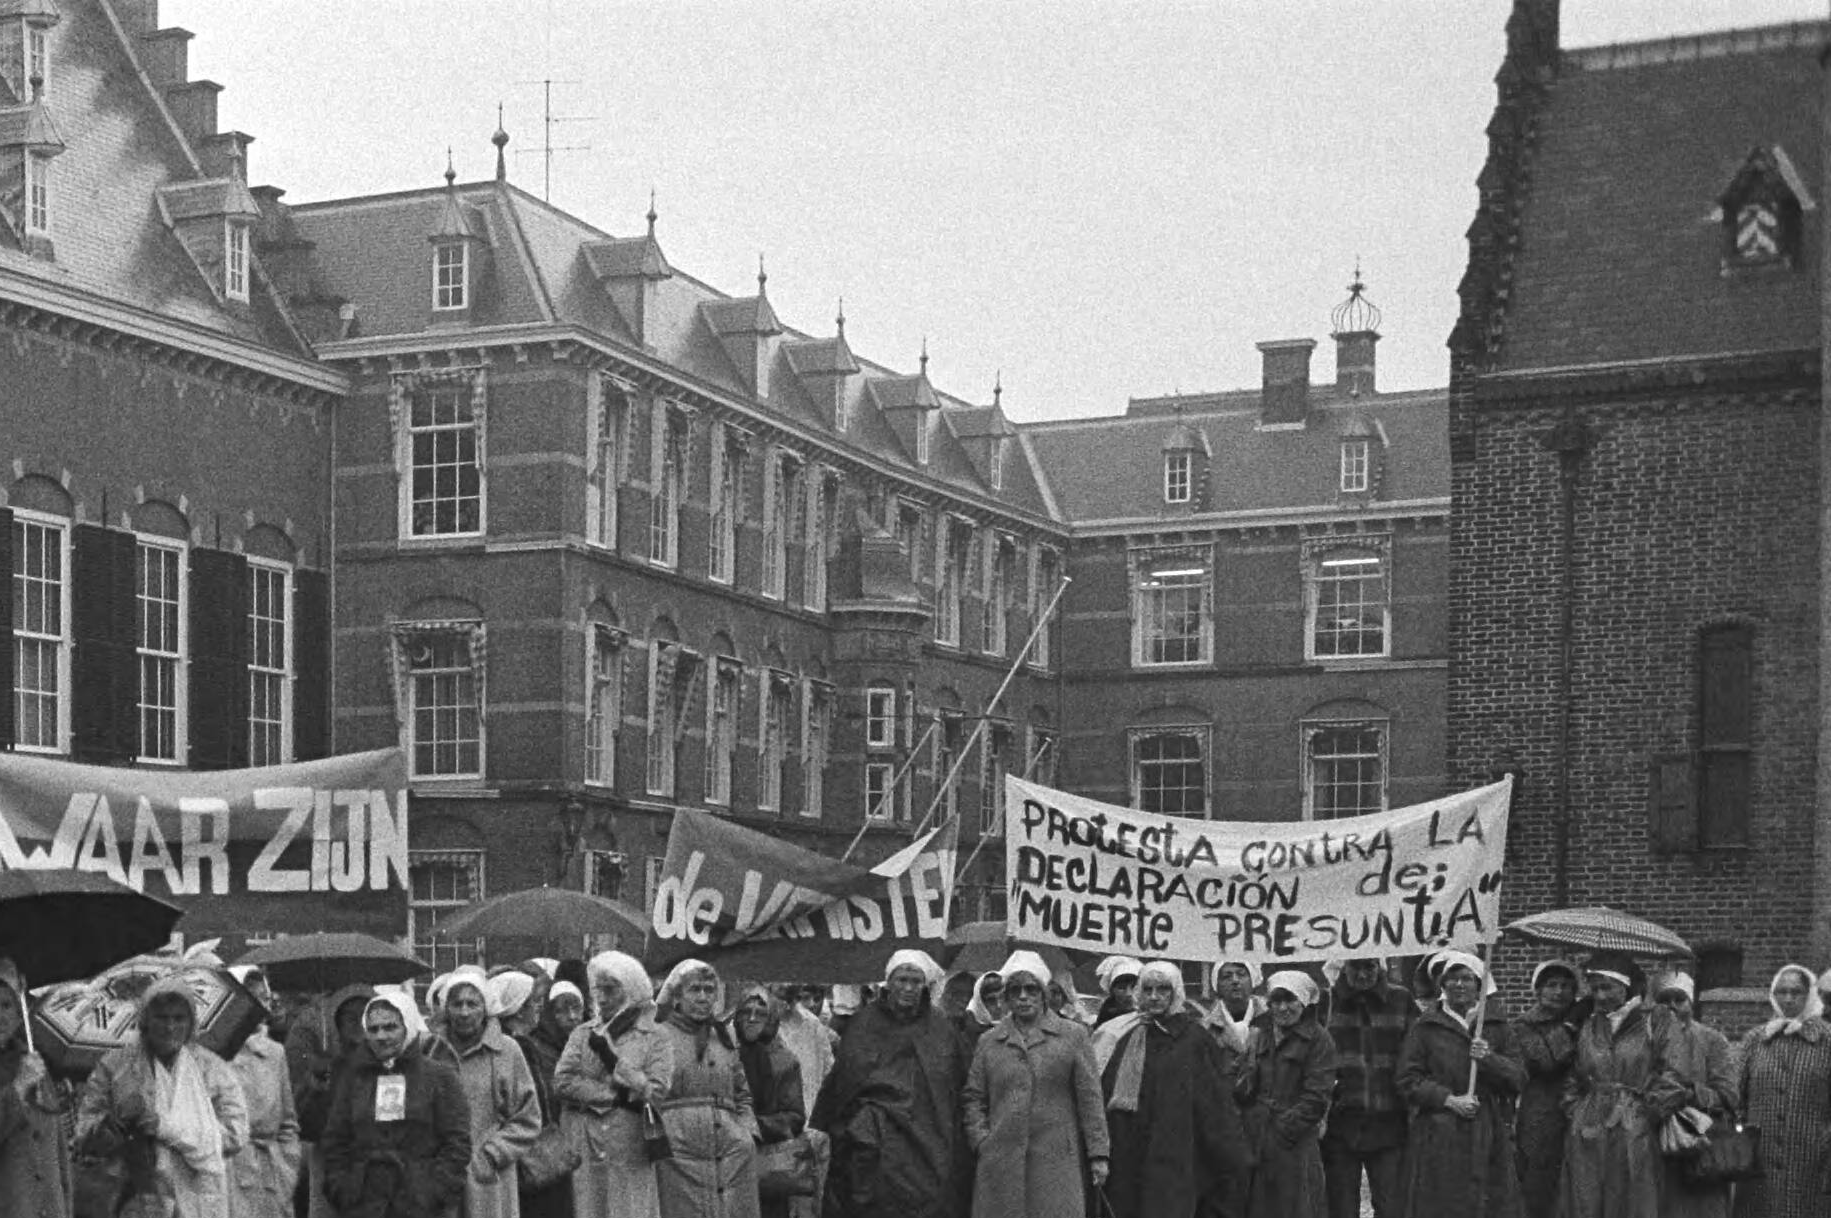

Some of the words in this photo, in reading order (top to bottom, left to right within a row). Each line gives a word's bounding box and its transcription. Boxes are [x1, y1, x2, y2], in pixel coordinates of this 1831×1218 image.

[247, 786, 409, 892] ZIJN
[1429, 807, 1486, 847] LA
[652, 850, 724, 946] de
